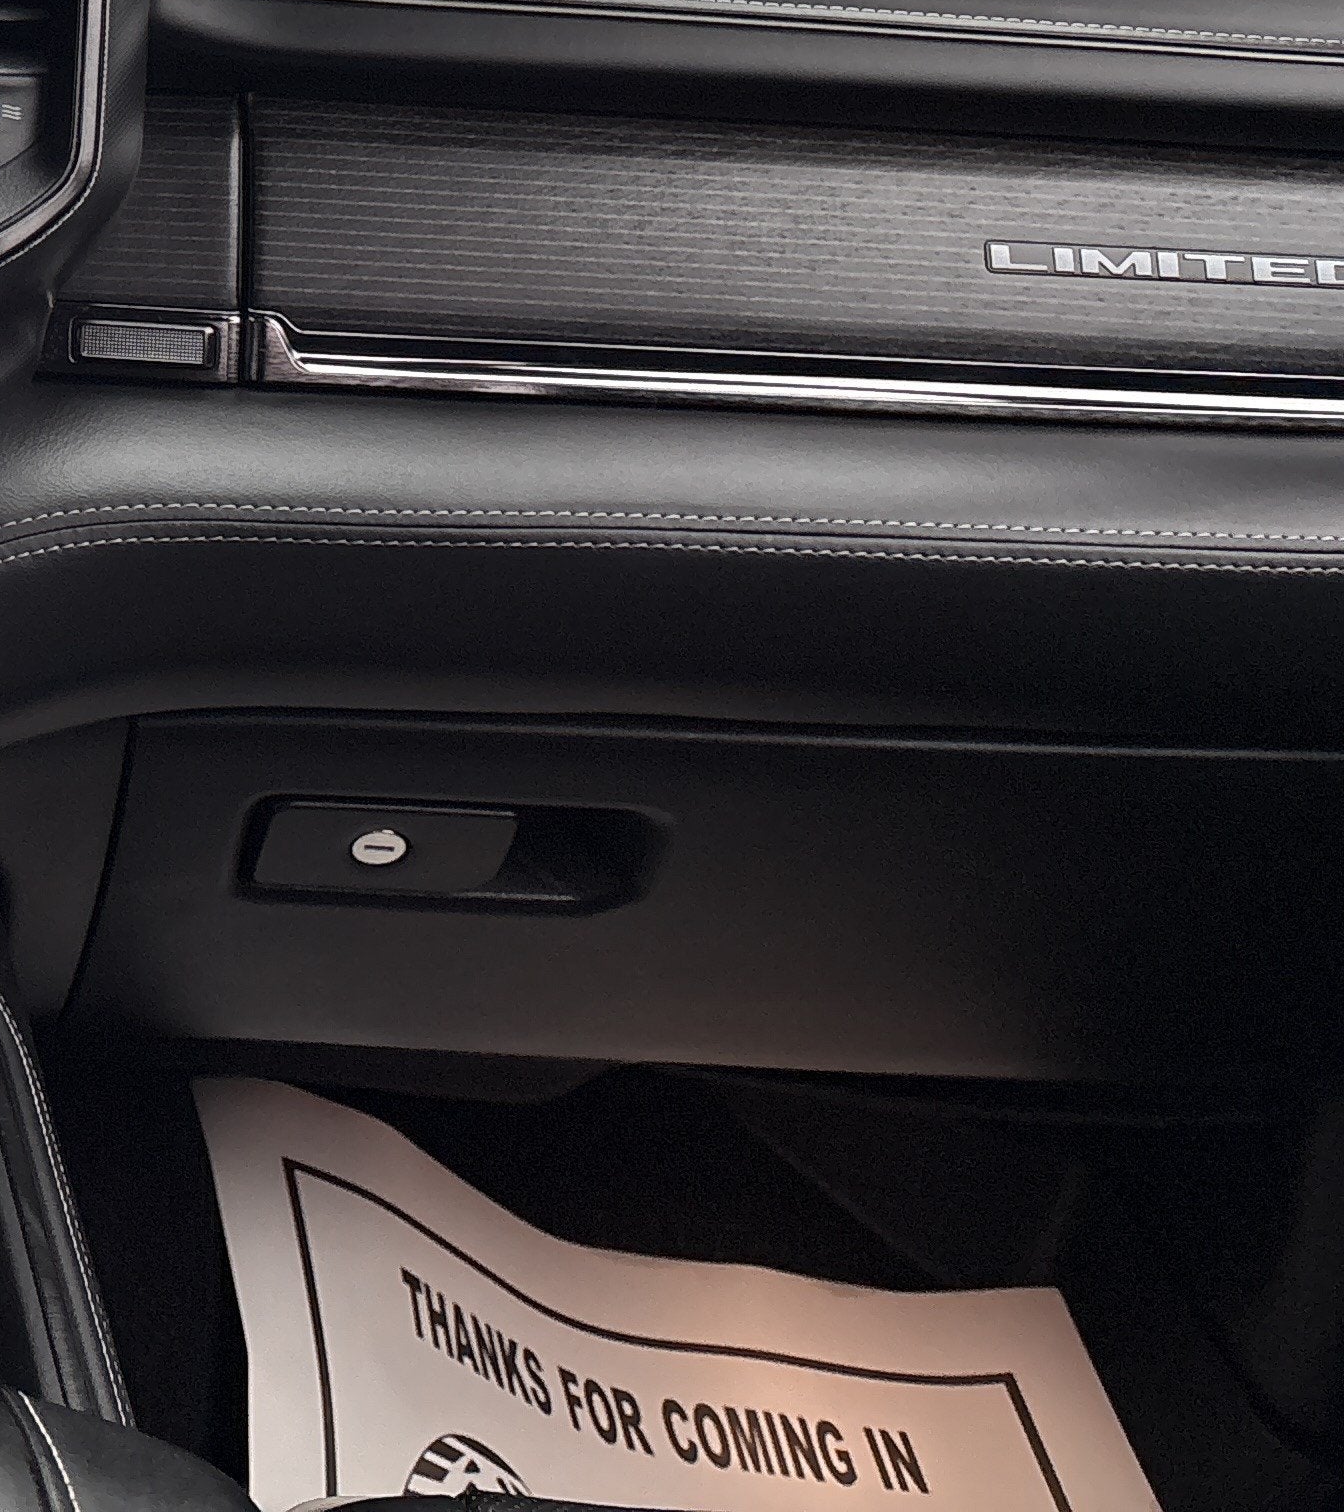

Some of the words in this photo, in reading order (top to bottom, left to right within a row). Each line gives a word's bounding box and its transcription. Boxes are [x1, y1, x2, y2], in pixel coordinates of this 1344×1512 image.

[399, 1266, 556, 1416] THANKS
[556, 1364, 654, 1455] FOR
[661, 1398, 858, 1488] COMING
[861, 1424, 931, 1495] IN
